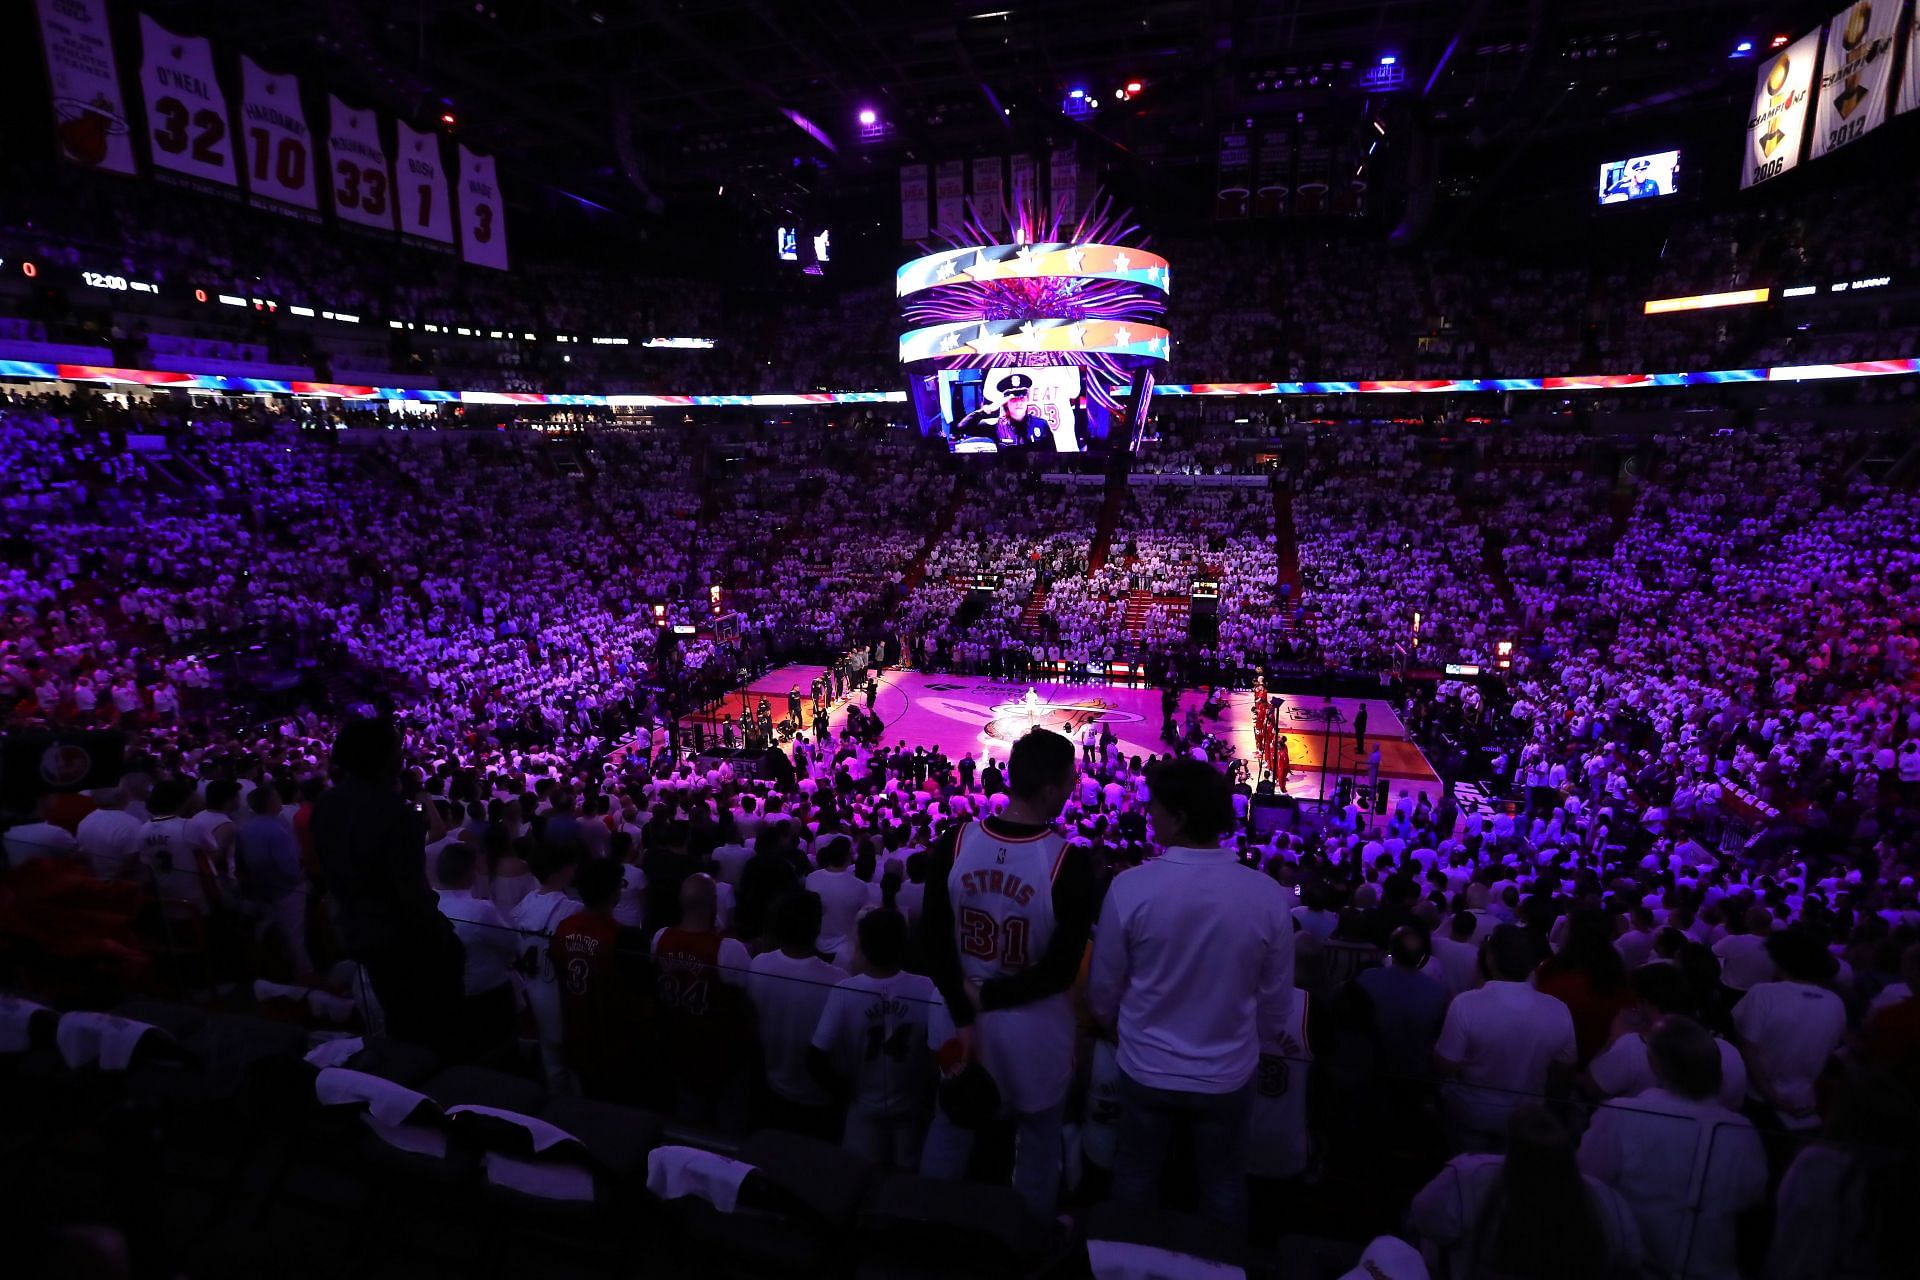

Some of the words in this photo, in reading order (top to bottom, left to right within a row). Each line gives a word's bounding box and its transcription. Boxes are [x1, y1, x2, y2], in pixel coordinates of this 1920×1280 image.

[157, 66, 210, 100] O'NEAL
[154, 96, 225, 167] 32
[1827, 115, 1867, 152] 2012
[250, 127, 306, 190] 10
[1753, 157, 1784, 184] 2006
[336, 159, 387, 215] 33
[417, 184, 432, 227] 1
[473, 203, 493, 243] 3
[22, 262, 36, 277] 0
[82, 271, 128, 290] 12:00
[195, 289, 207, 302] 0
[1027, 386, 1060, 401] EAT
[961, 869, 1035, 906] STRUS
[960, 906, 1028, 967] 31
[566, 958, 591, 996] 3
